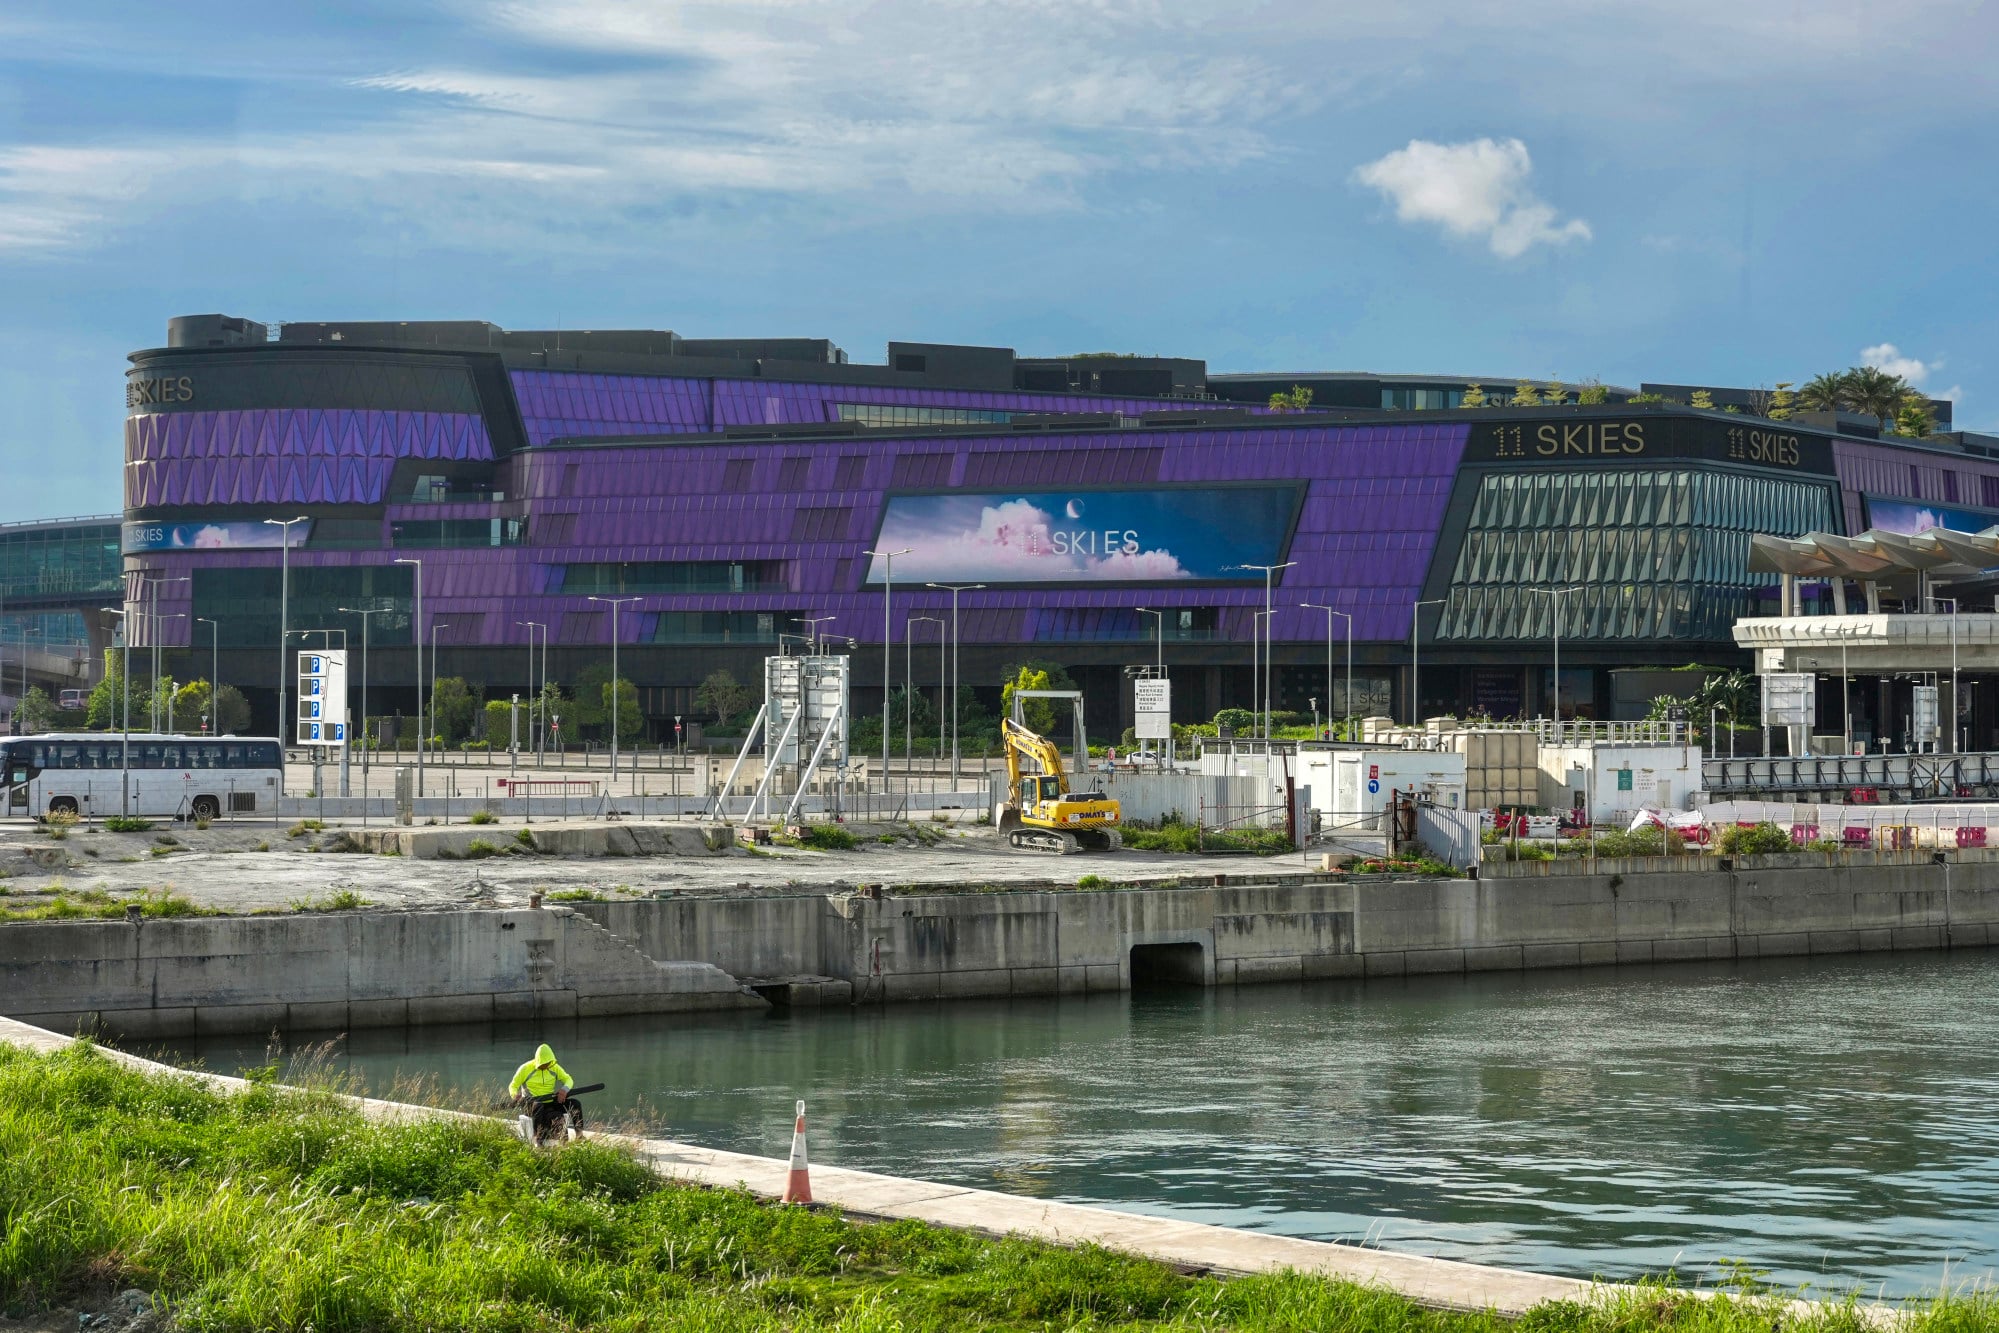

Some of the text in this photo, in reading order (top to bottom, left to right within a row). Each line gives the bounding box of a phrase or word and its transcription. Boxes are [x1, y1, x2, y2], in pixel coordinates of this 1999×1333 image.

[134, 376, 193, 405] SKIES
[1492, 423, 1645, 457] 11 SKIES
[1726, 427, 1800, 465] 11 SKIES
[135, 528, 163, 542] SKIES
[1052, 530, 1139, 555] SKIES
[1359, 692, 1390, 705] SKIE
[1075, 810, 1109, 819] OMATS
